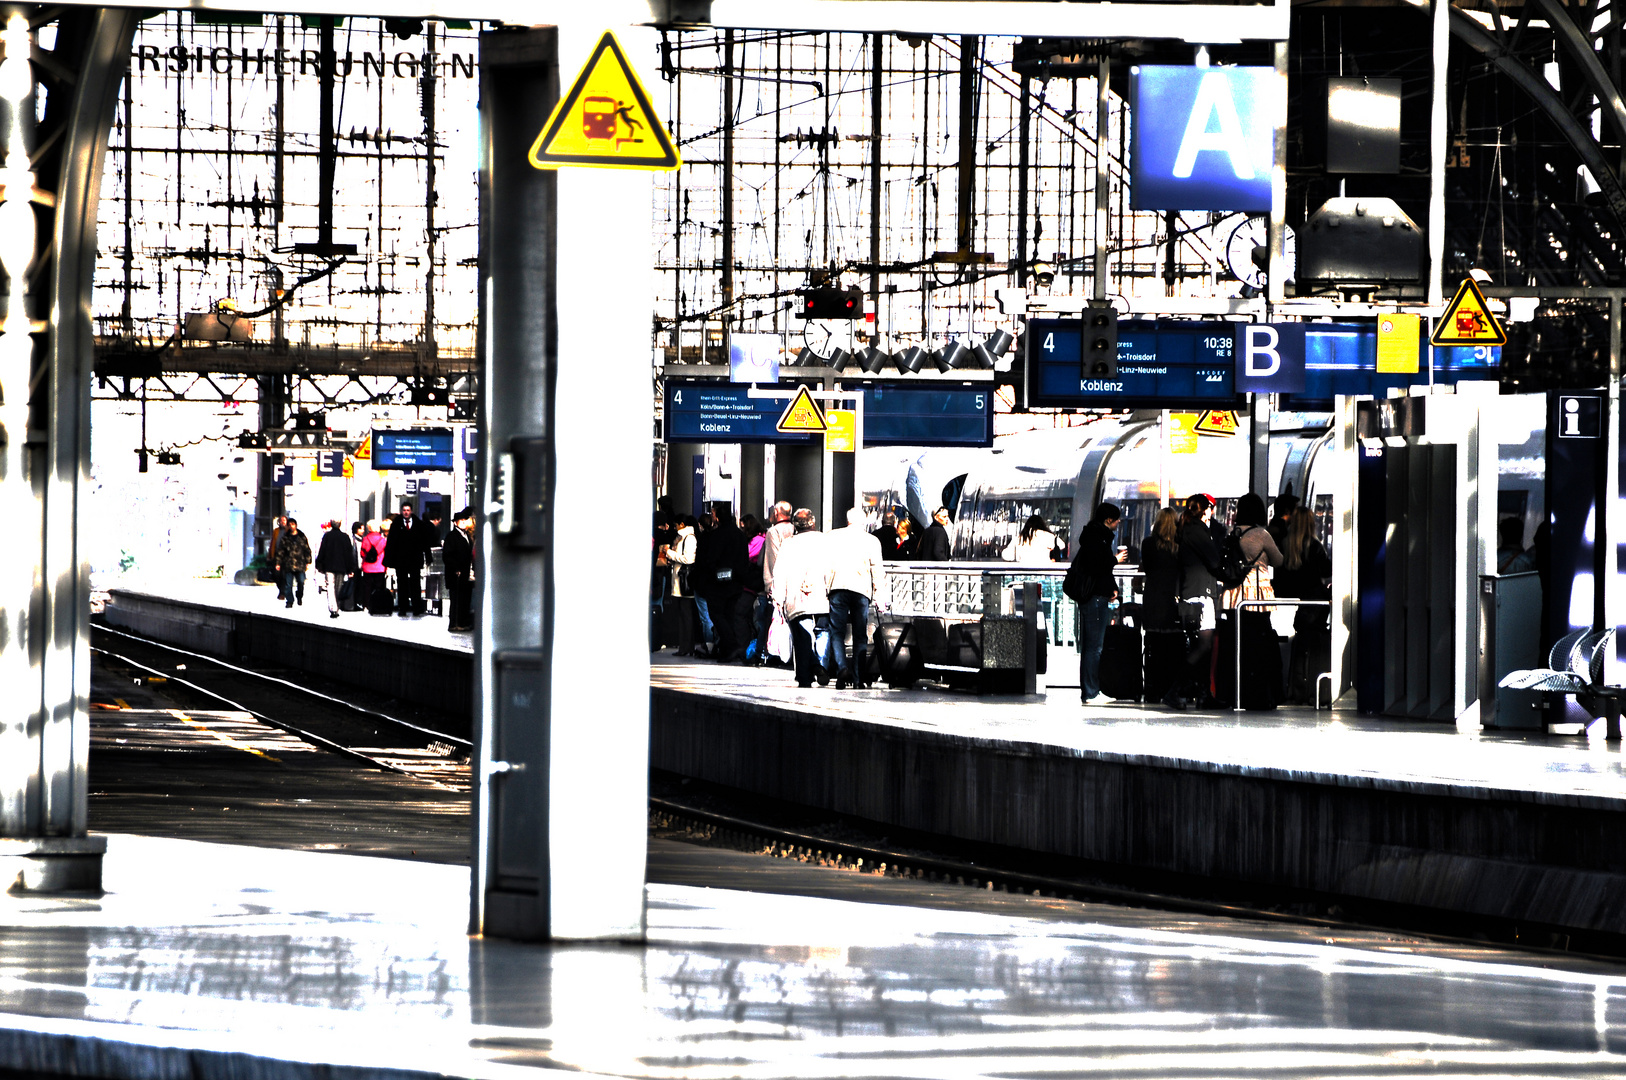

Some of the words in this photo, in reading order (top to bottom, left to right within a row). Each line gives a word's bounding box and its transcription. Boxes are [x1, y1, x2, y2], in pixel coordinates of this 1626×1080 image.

[138, 44, 474, 79] RSICHERUNGEN
[1172, 71, 1256, 180] A
[1043, 332, 1055, 353] 4
[1203, 337, 1233, 349] 10:38
[1245, 324, 1282, 377] B
[1216, 349, 1225, 357] RE
[1226, 349, 1232, 357] 8
[1080, 379, 1124, 392] Koblenz
[673, 389, 683, 405] 4
[975, 394, 984, 410] 5
[700, 423, 731, 433] Koblenz
[377, 435, 385, 446] 4
[319, 451, 334, 473] E
[273, 464, 286, 483] F
